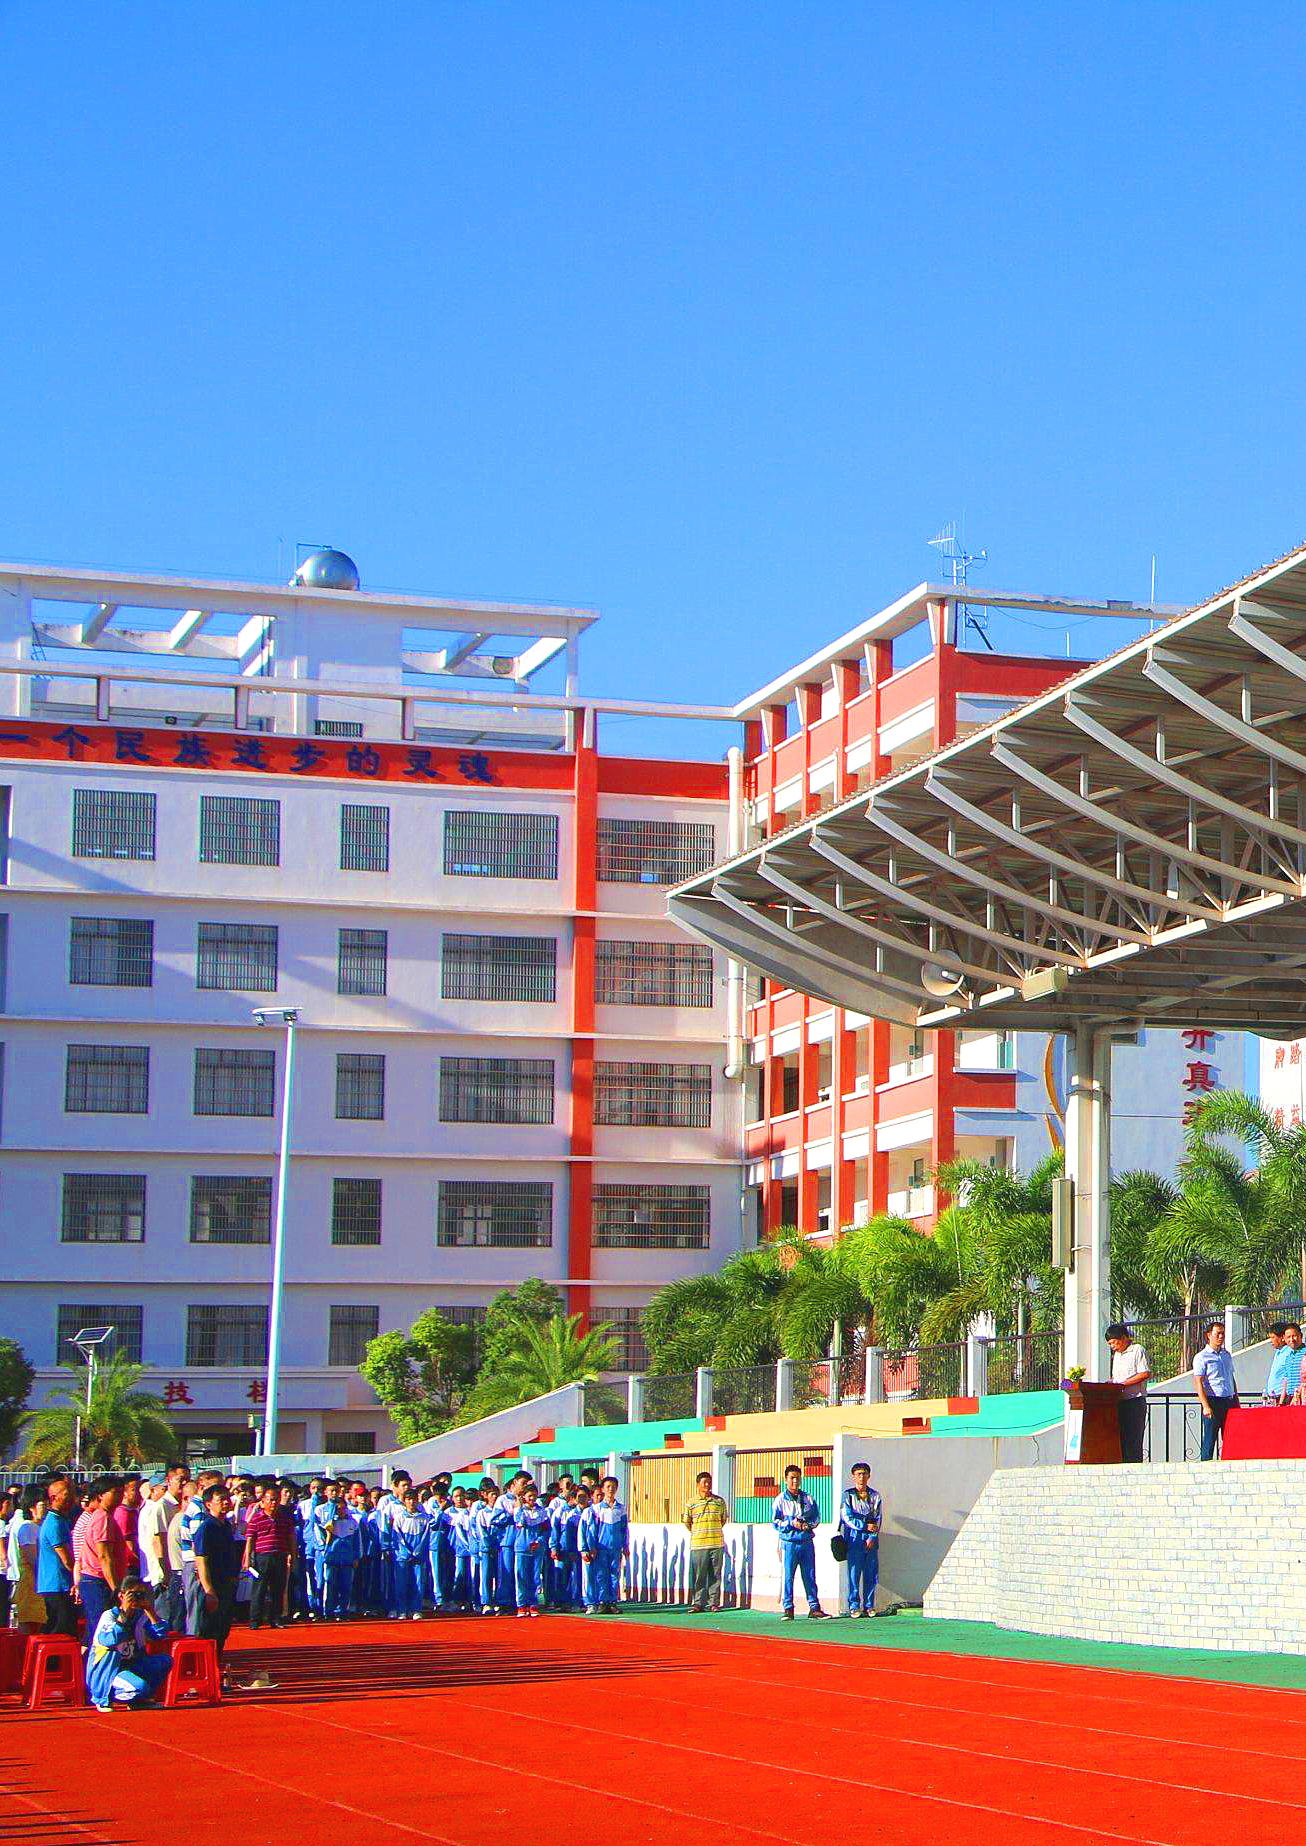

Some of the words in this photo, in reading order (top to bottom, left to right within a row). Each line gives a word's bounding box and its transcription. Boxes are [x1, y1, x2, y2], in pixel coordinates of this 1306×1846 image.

[0, 725, 494, 783] 一个民族进步的灵魂
